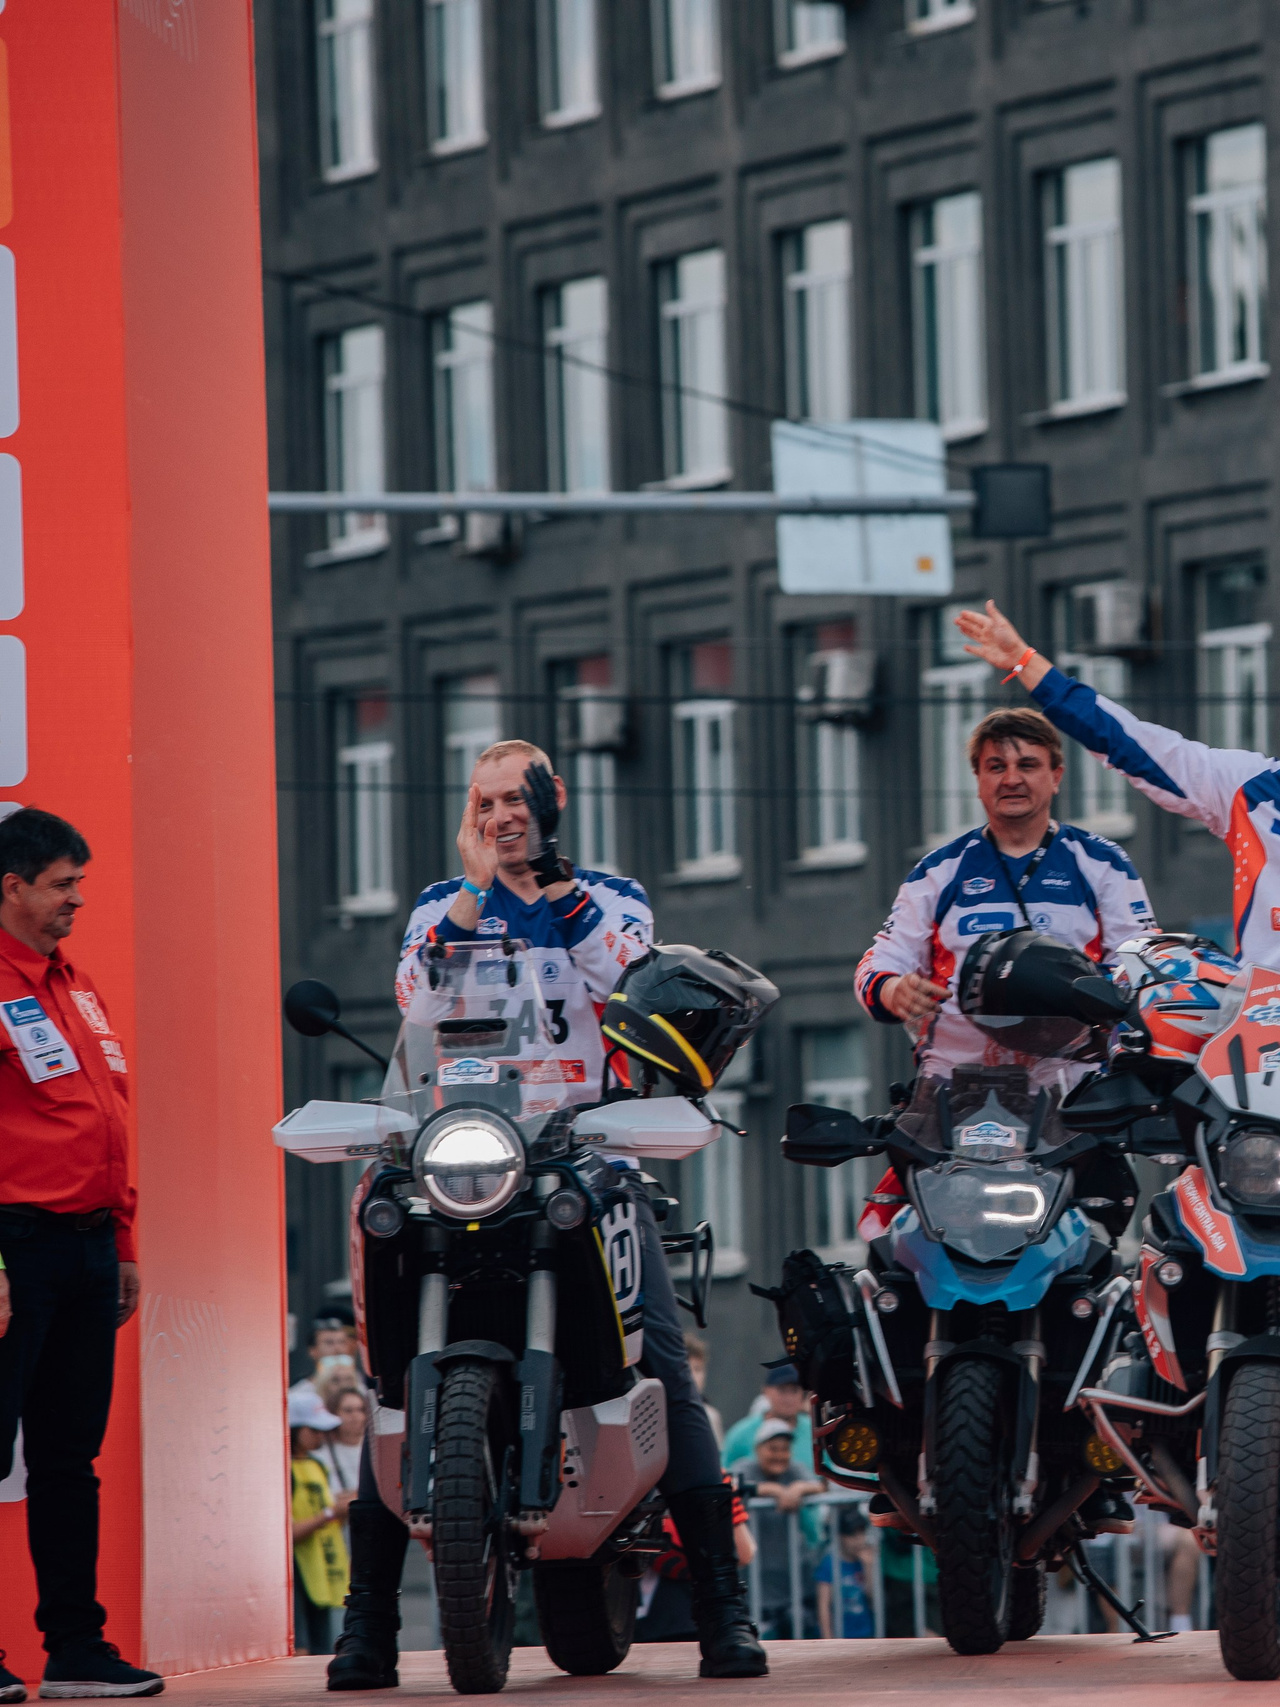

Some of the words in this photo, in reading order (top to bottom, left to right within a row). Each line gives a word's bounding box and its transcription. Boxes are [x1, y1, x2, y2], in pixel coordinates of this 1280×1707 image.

[1249, 984, 1275, 997] BMW
[1193, 1201, 1216, 1235] CENTRAL
[1209, 1231, 1228, 1253] ASIA
